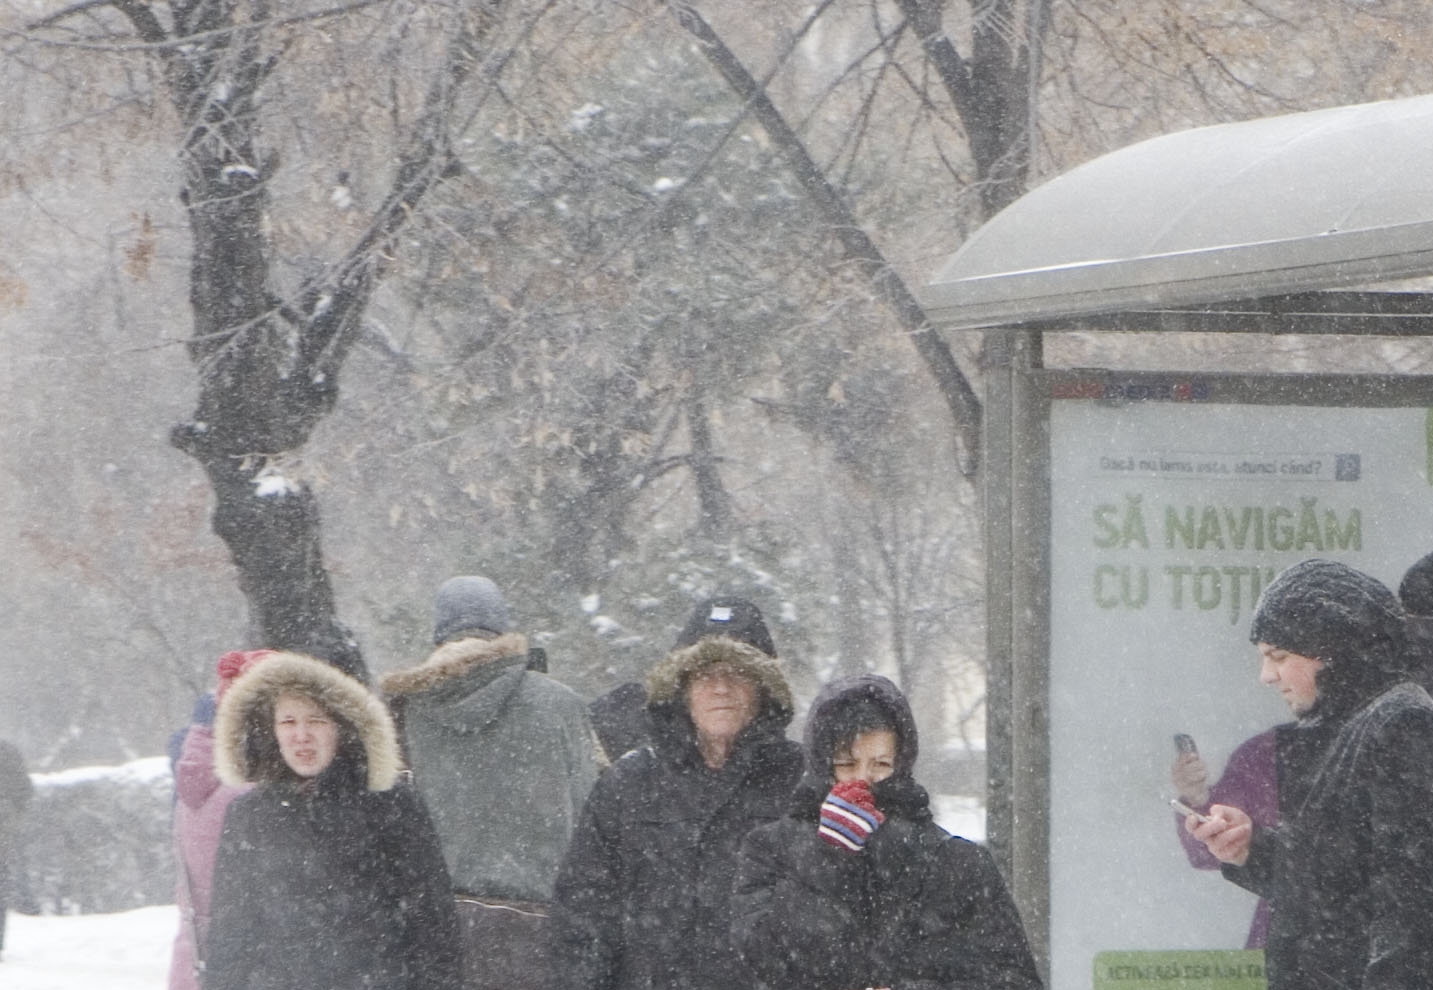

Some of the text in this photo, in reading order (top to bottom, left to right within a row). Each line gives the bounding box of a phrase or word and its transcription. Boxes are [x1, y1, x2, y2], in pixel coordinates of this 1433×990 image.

[1093, 493, 1363, 552] SĂ NAVIGĂM
[1093, 564, 1149, 609] CU
